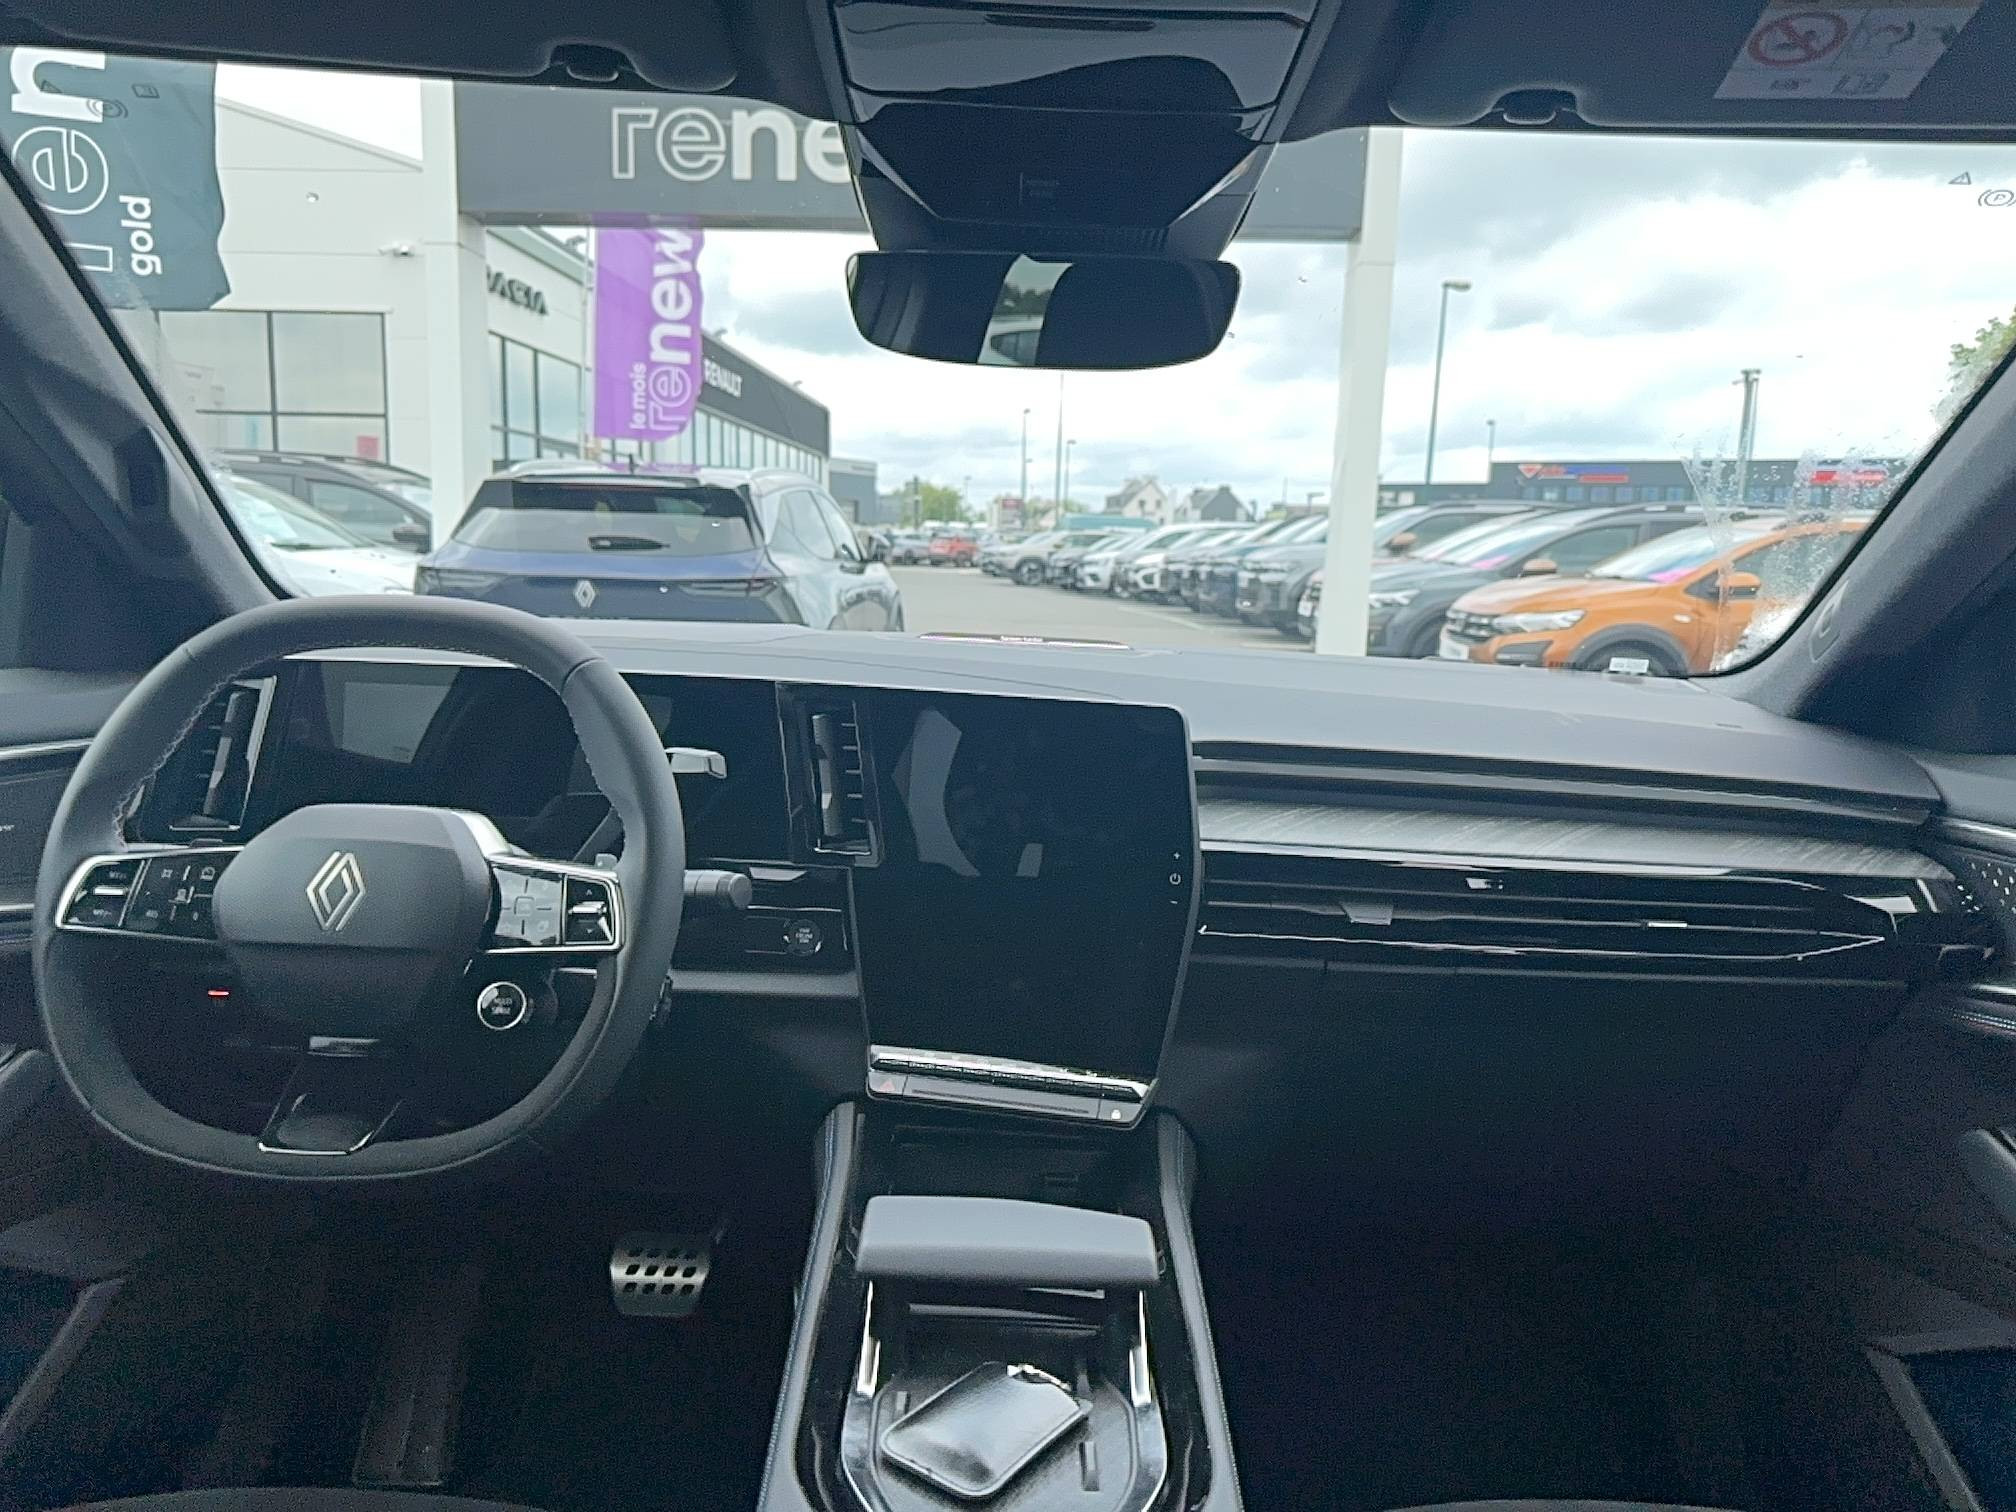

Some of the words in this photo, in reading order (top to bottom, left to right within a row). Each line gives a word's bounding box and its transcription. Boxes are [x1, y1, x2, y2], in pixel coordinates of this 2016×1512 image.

[612, 106, 852, 184] rene
[118, 194, 163, 275] gold
[649, 218, 693, 432] renew
[629, 361, 647, 408] mois
[629, 408, 647, 430] le
